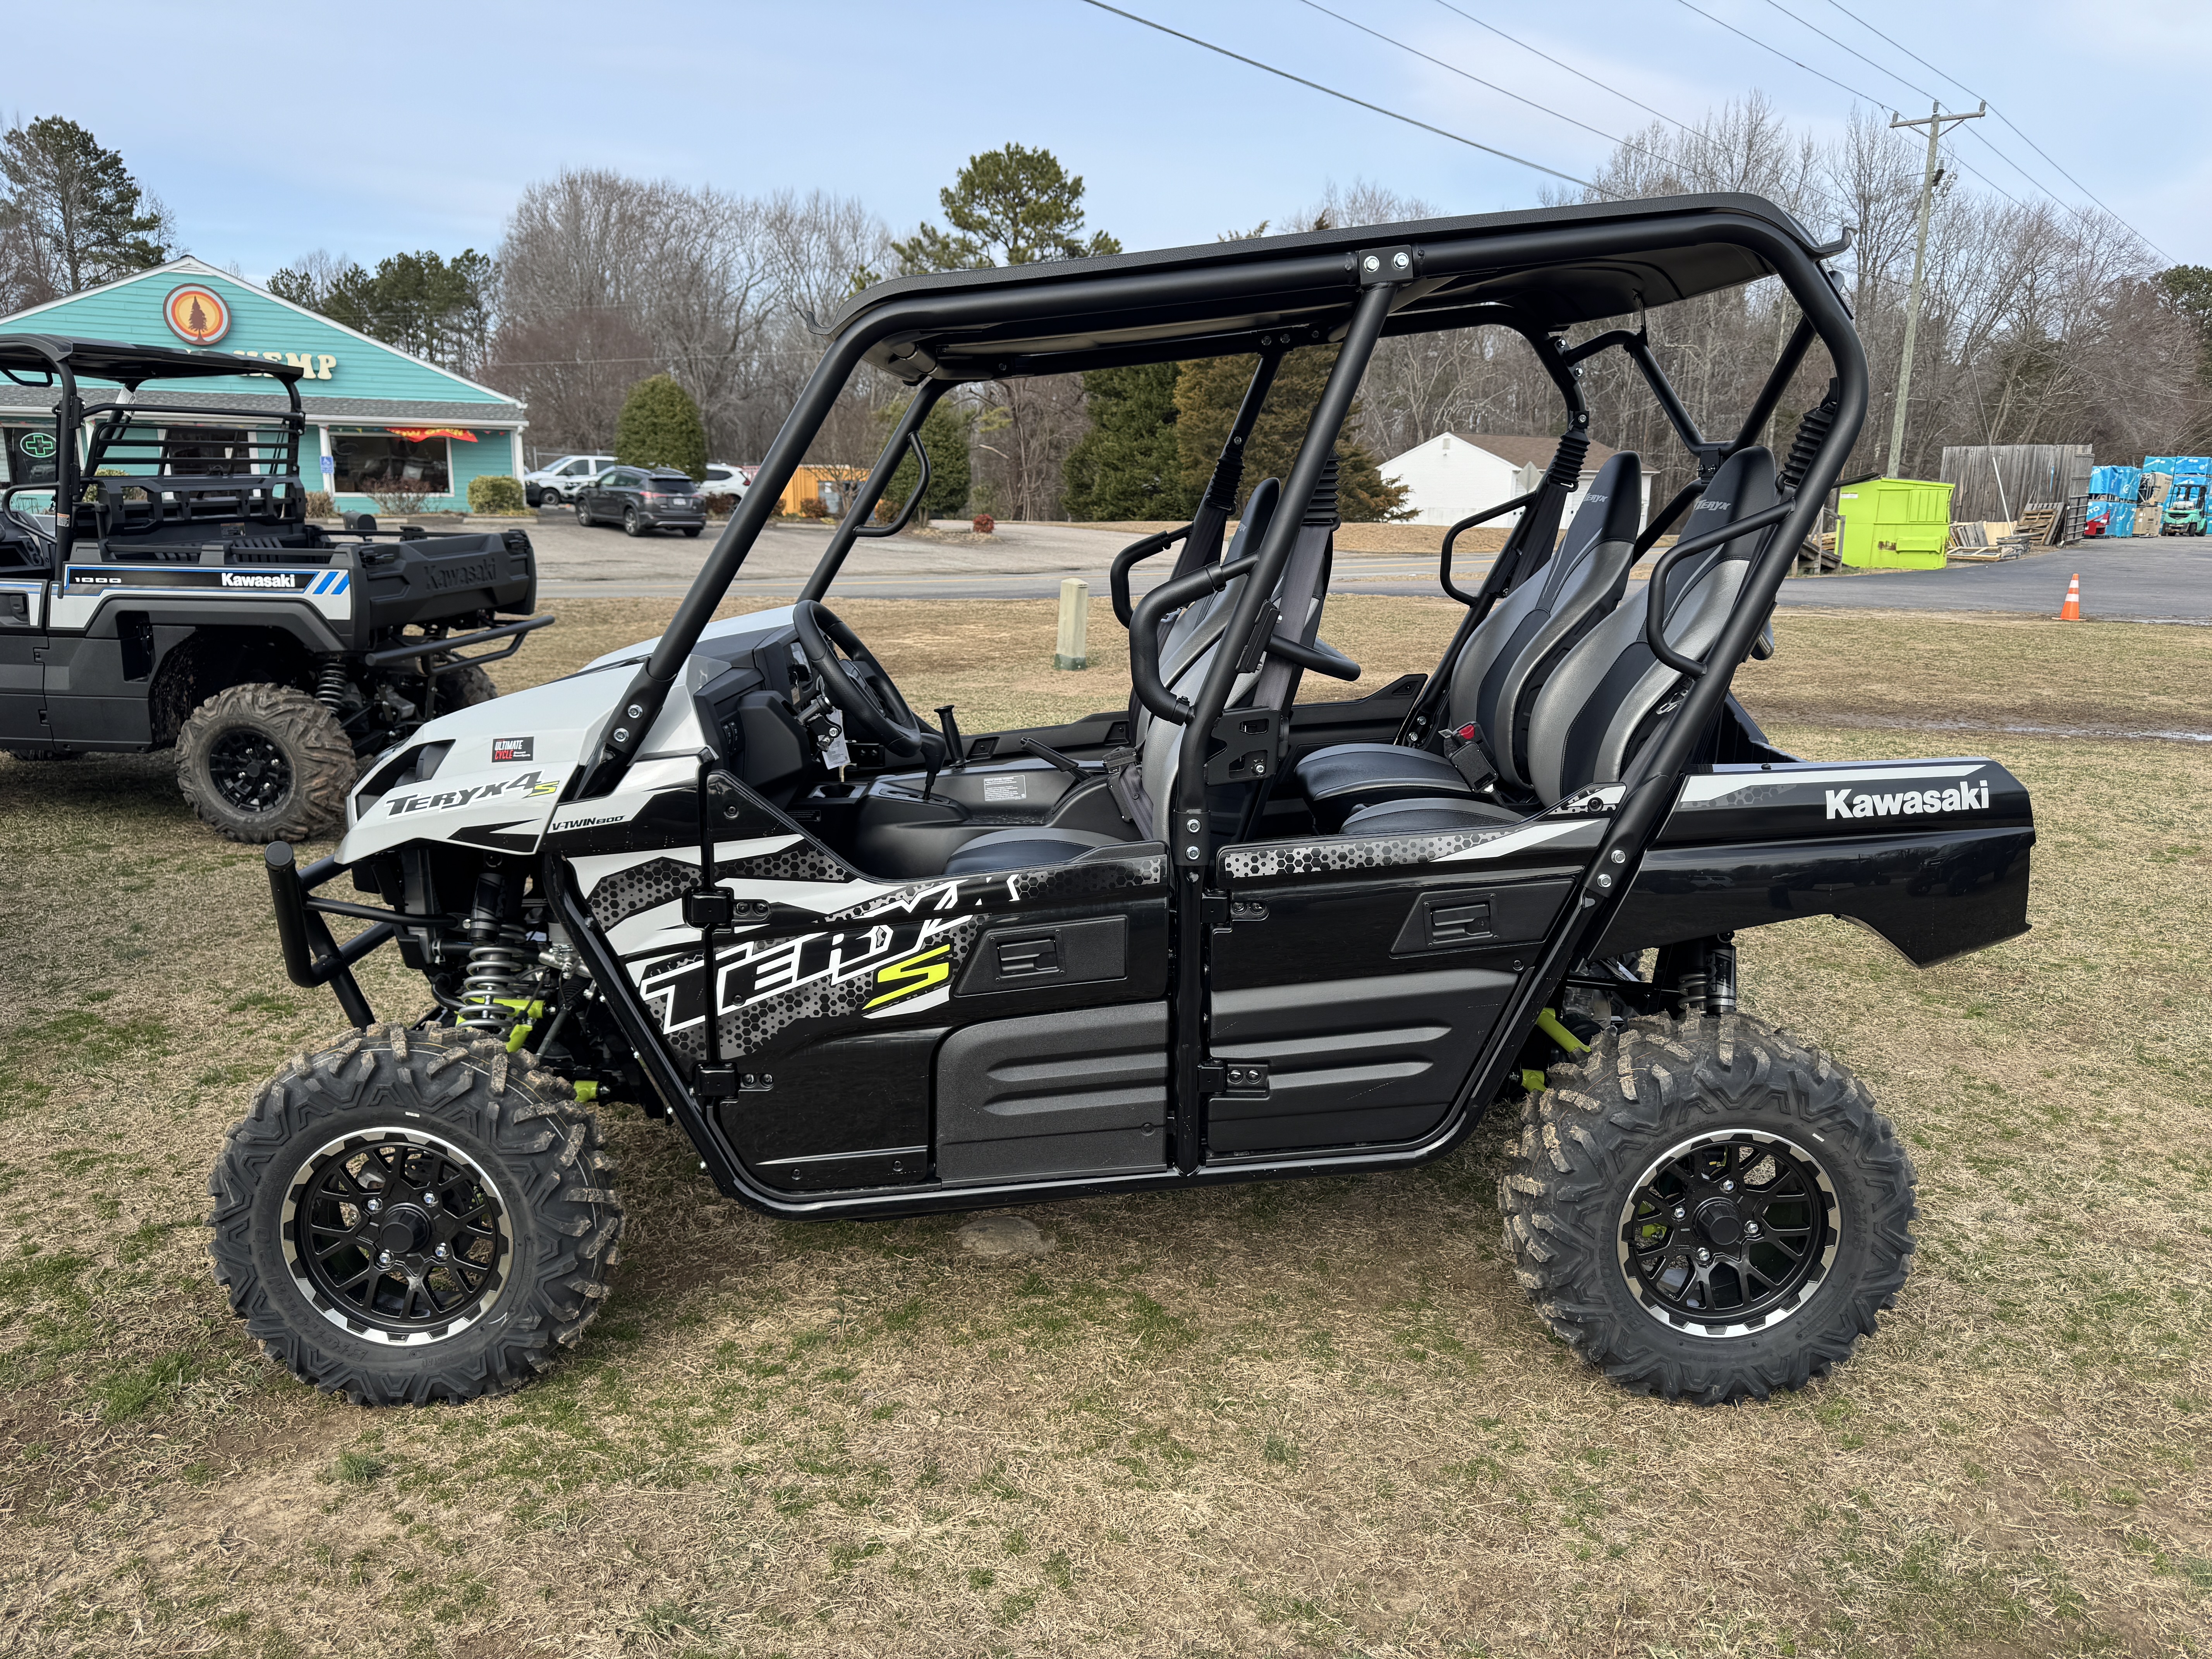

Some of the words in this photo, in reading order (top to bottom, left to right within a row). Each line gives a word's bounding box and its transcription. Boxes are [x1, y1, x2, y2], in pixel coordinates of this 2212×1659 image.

[233, 350, 336, 380] EMP
[1694, 499, 1731, 511] TERYX
[222, 573, 295, 587] Kawasaki
[424, 558, 496, 589] Kawasaki
[495, 740, 523, 750] ULTIMATE
[495, 750, 514, 760] CYCLE
[1825, 780, 1989, 819] Kawasaki
[1824, 1151, 1867, 1251] MAXXIS
[1599, 1225, 1645, 1332] BIGHORN
[267, 1276, 368, 1362] BIGHORN
